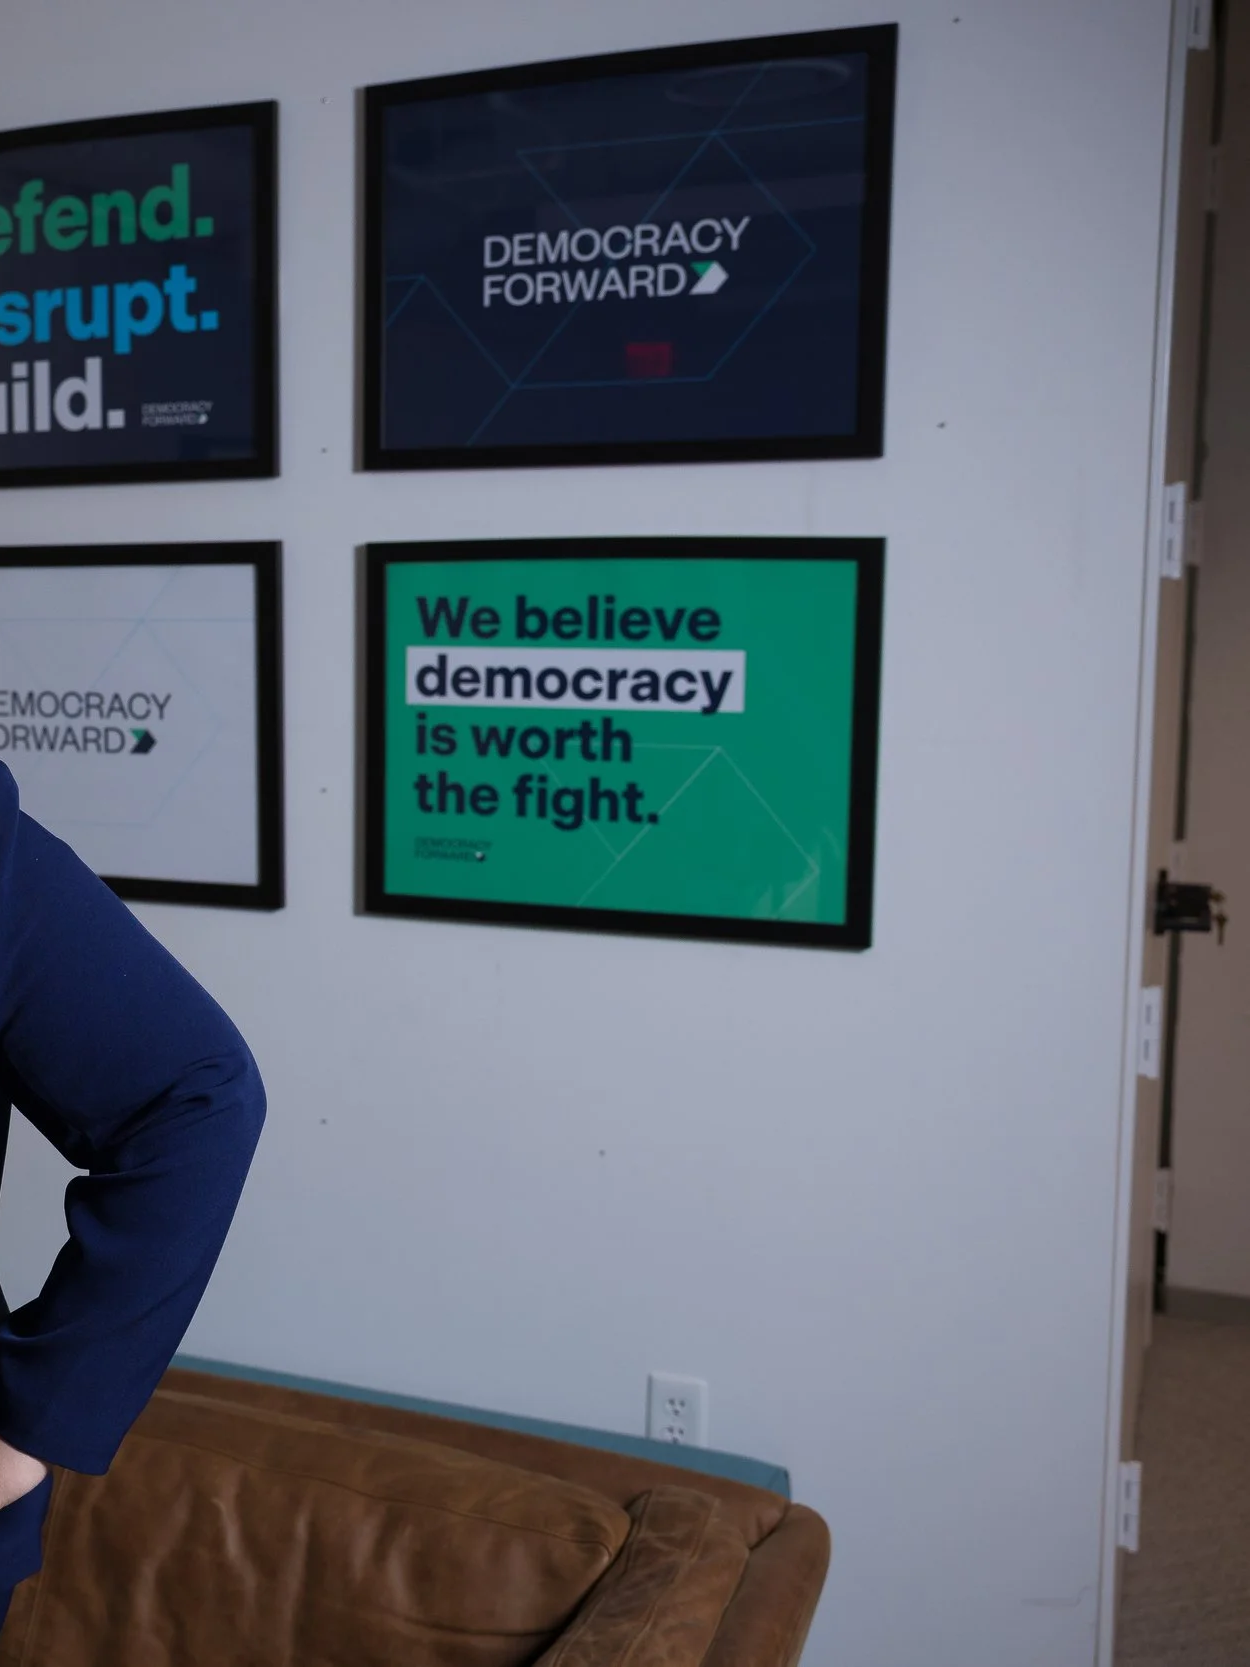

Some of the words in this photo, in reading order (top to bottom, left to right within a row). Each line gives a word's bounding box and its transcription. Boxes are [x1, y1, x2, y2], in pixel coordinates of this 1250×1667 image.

[483, 216, 750, 269] DEMOCRACY
[483, 262, 688, 308] FORWARD
[415, 596, 501, 640] We
[516, 594, 721, 642] believe
[415, 653, 733, 715] democracy
[416, 711, 457, 756] is
[471, 716, 632, 763] worth
[414, 770, 500, 816] the
[512, 773, 659, 831] fight.
